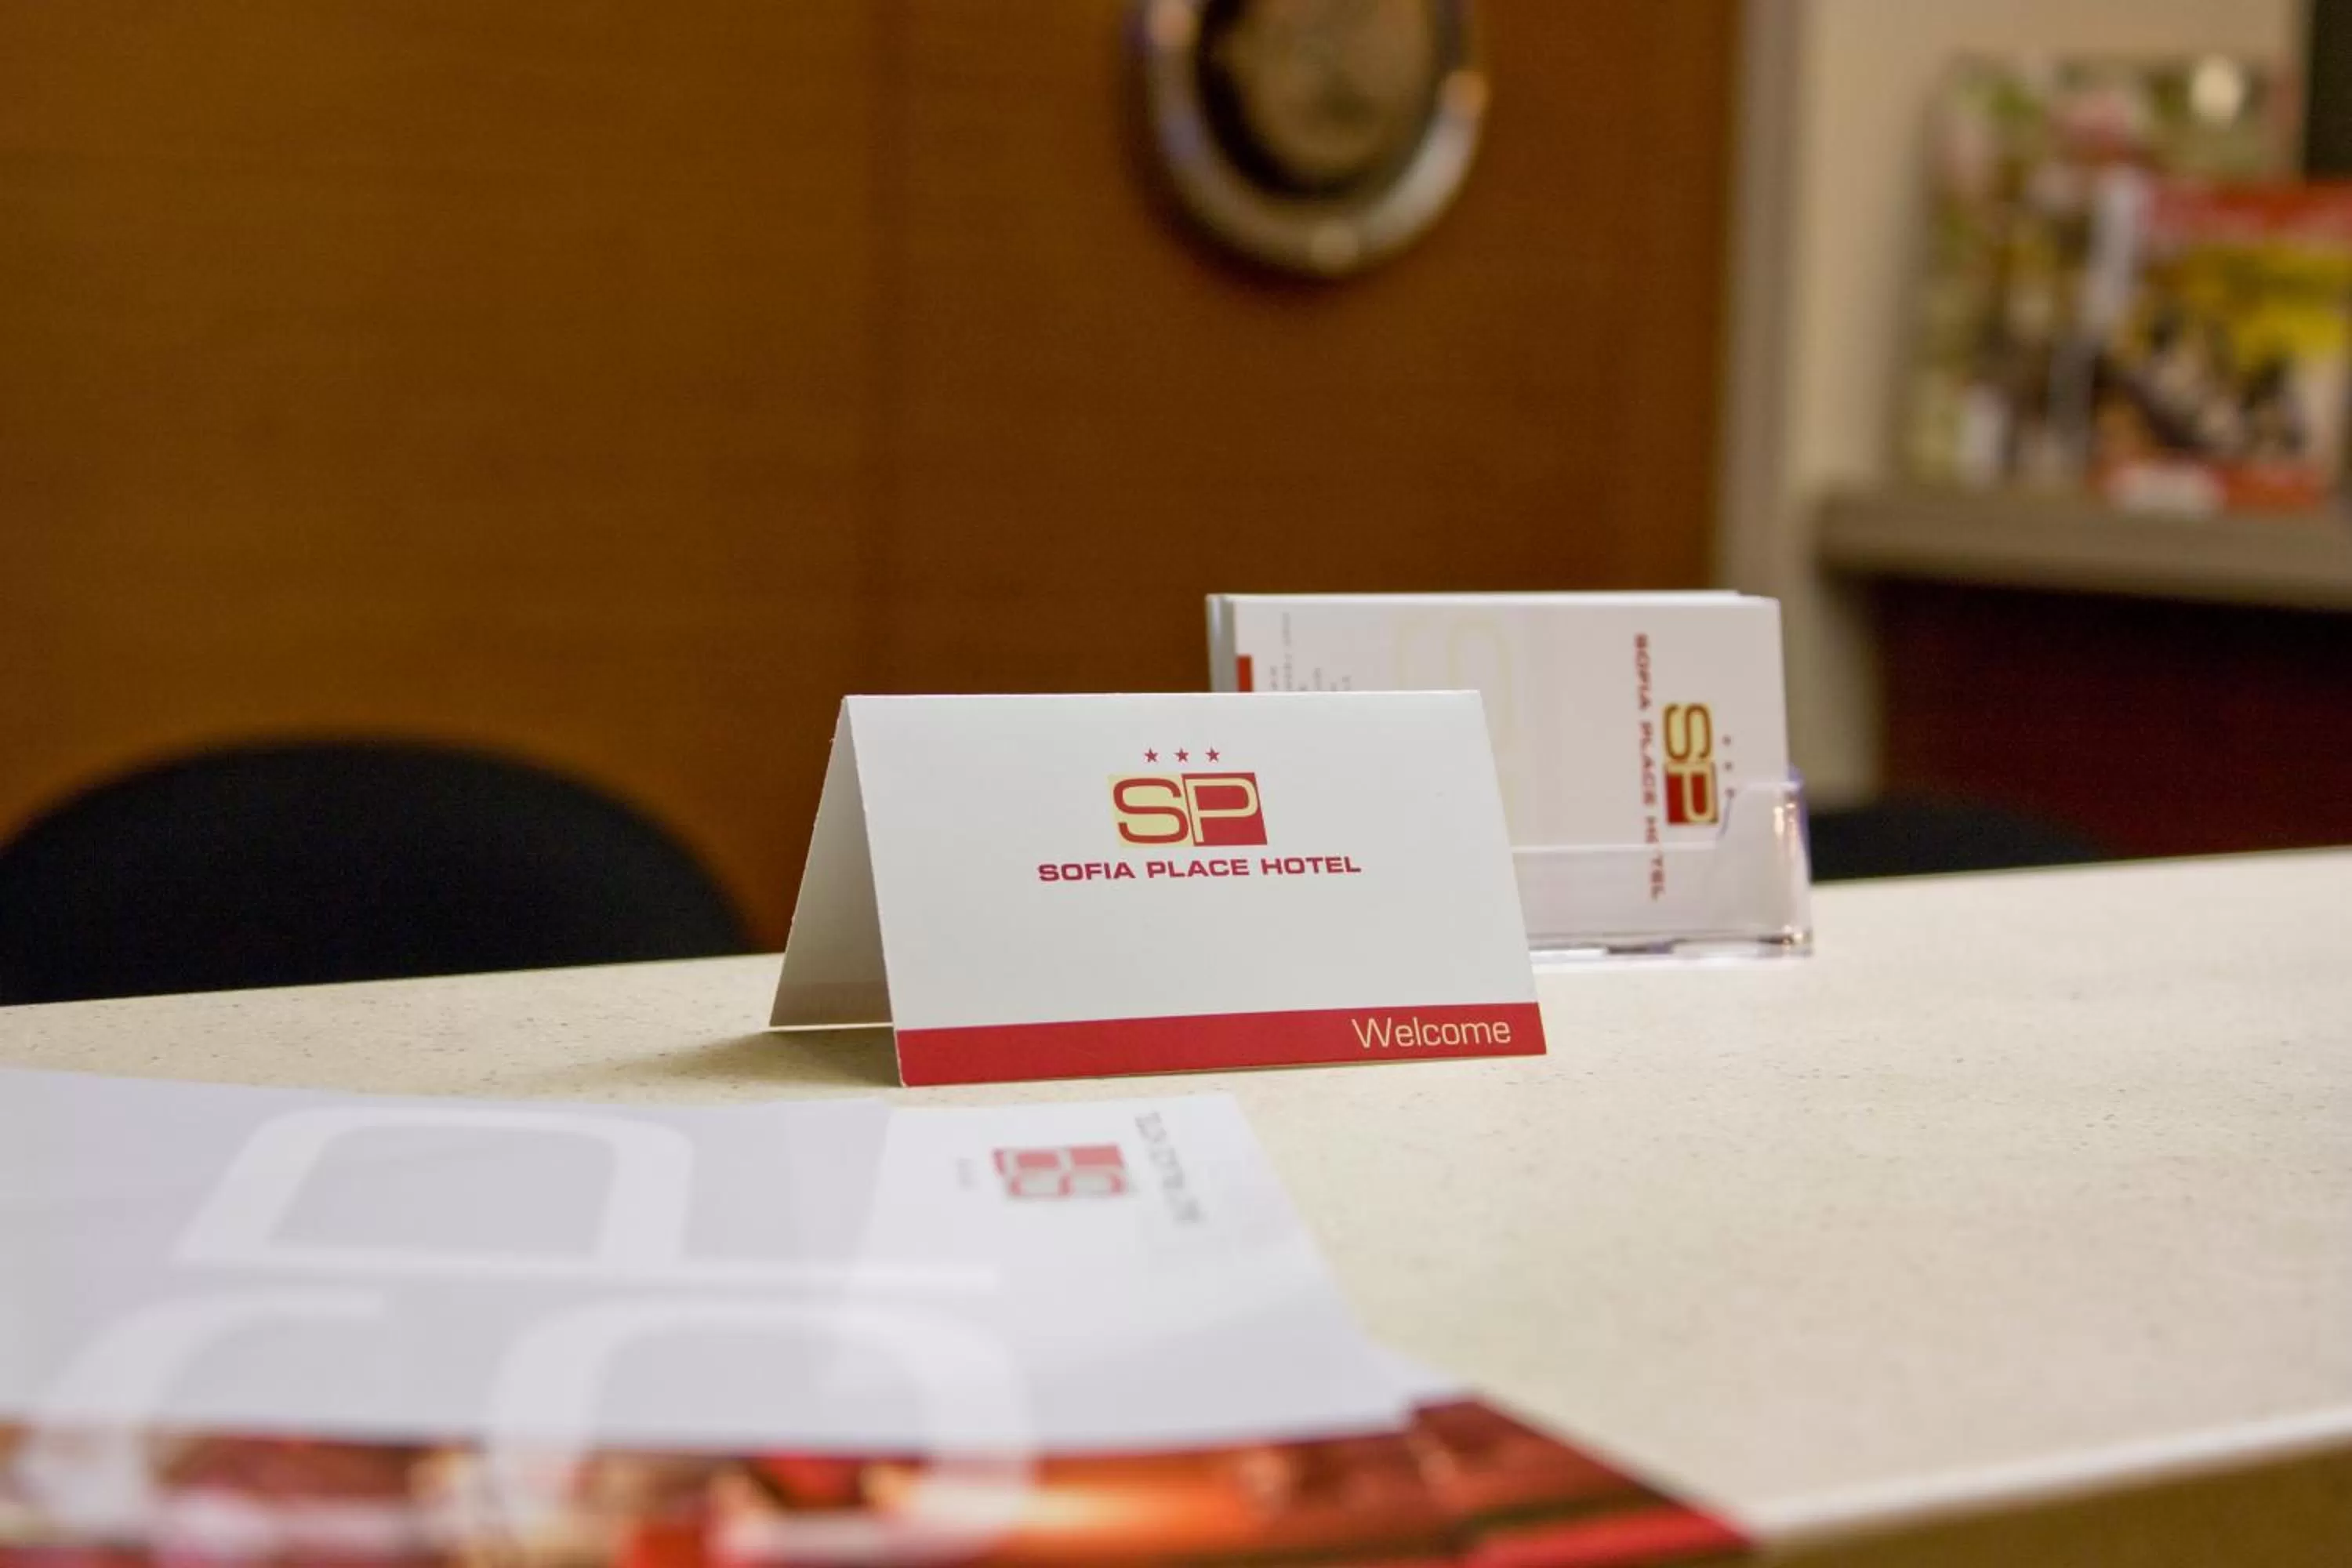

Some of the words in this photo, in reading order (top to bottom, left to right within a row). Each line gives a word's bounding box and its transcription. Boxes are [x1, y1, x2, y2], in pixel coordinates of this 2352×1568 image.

[1663, 703, 1716, 824] SP
[1112, 776, 1259, 844] SP
[1039, 862, 1136, 882] SOFIA
[1146, 858, 1250, 878] PLACE
[1260, 856, 1362, 877] HOTEL
[1351, 1017, 1512, 1048] Welcome
